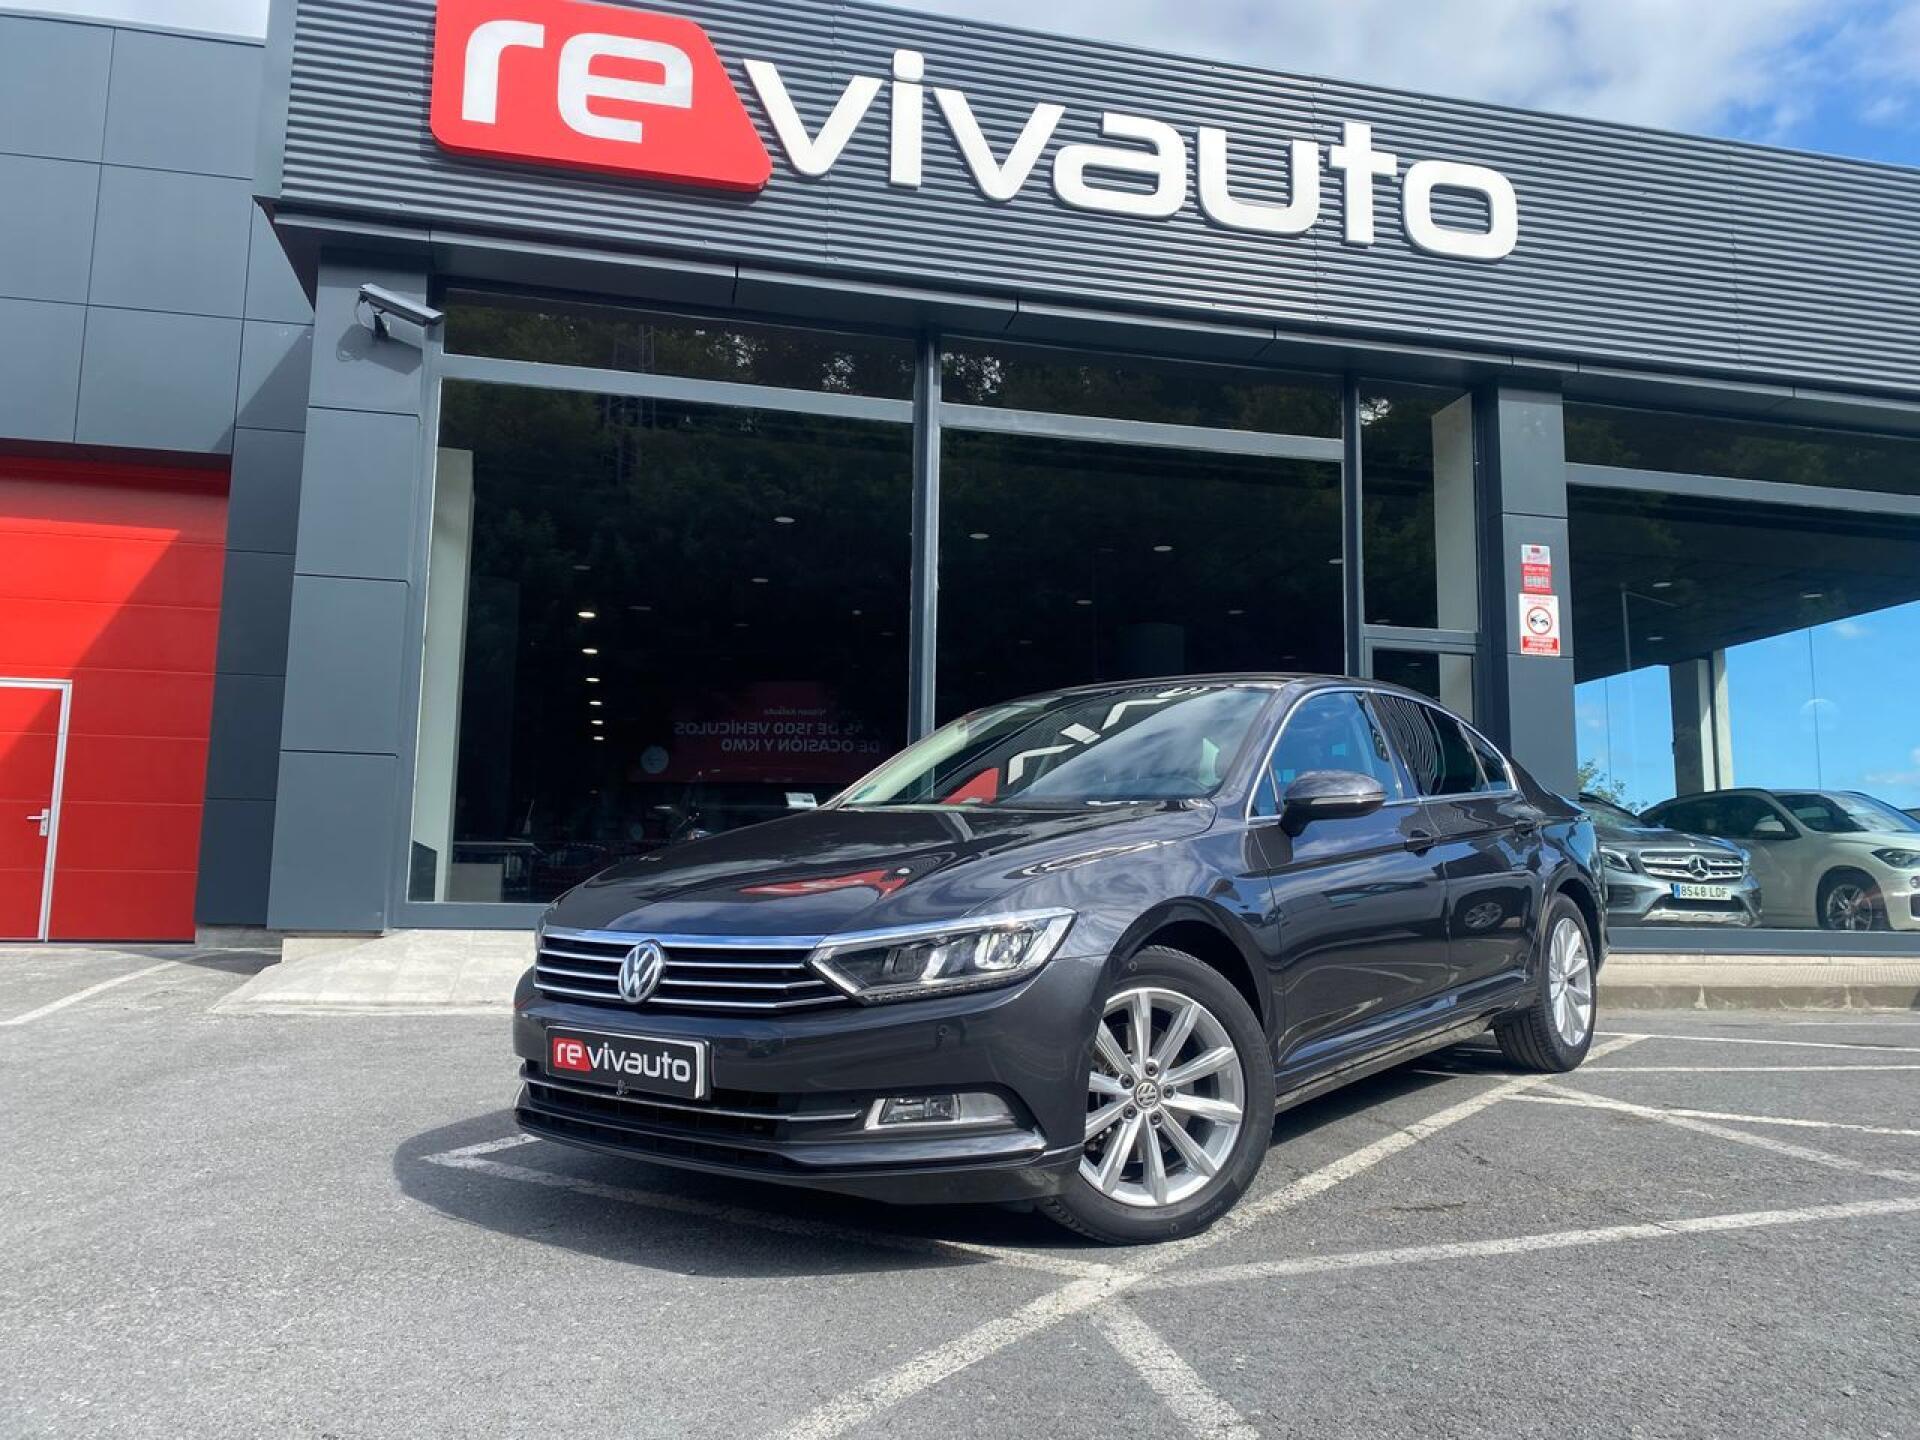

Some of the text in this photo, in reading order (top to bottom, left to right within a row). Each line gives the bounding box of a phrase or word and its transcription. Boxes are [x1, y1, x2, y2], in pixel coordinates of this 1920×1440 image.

[461, 18, 1519, 261] revivauto
[1681, 885, 1706, 898] 8548
[556, 1041, 691, 1083] revivauto
